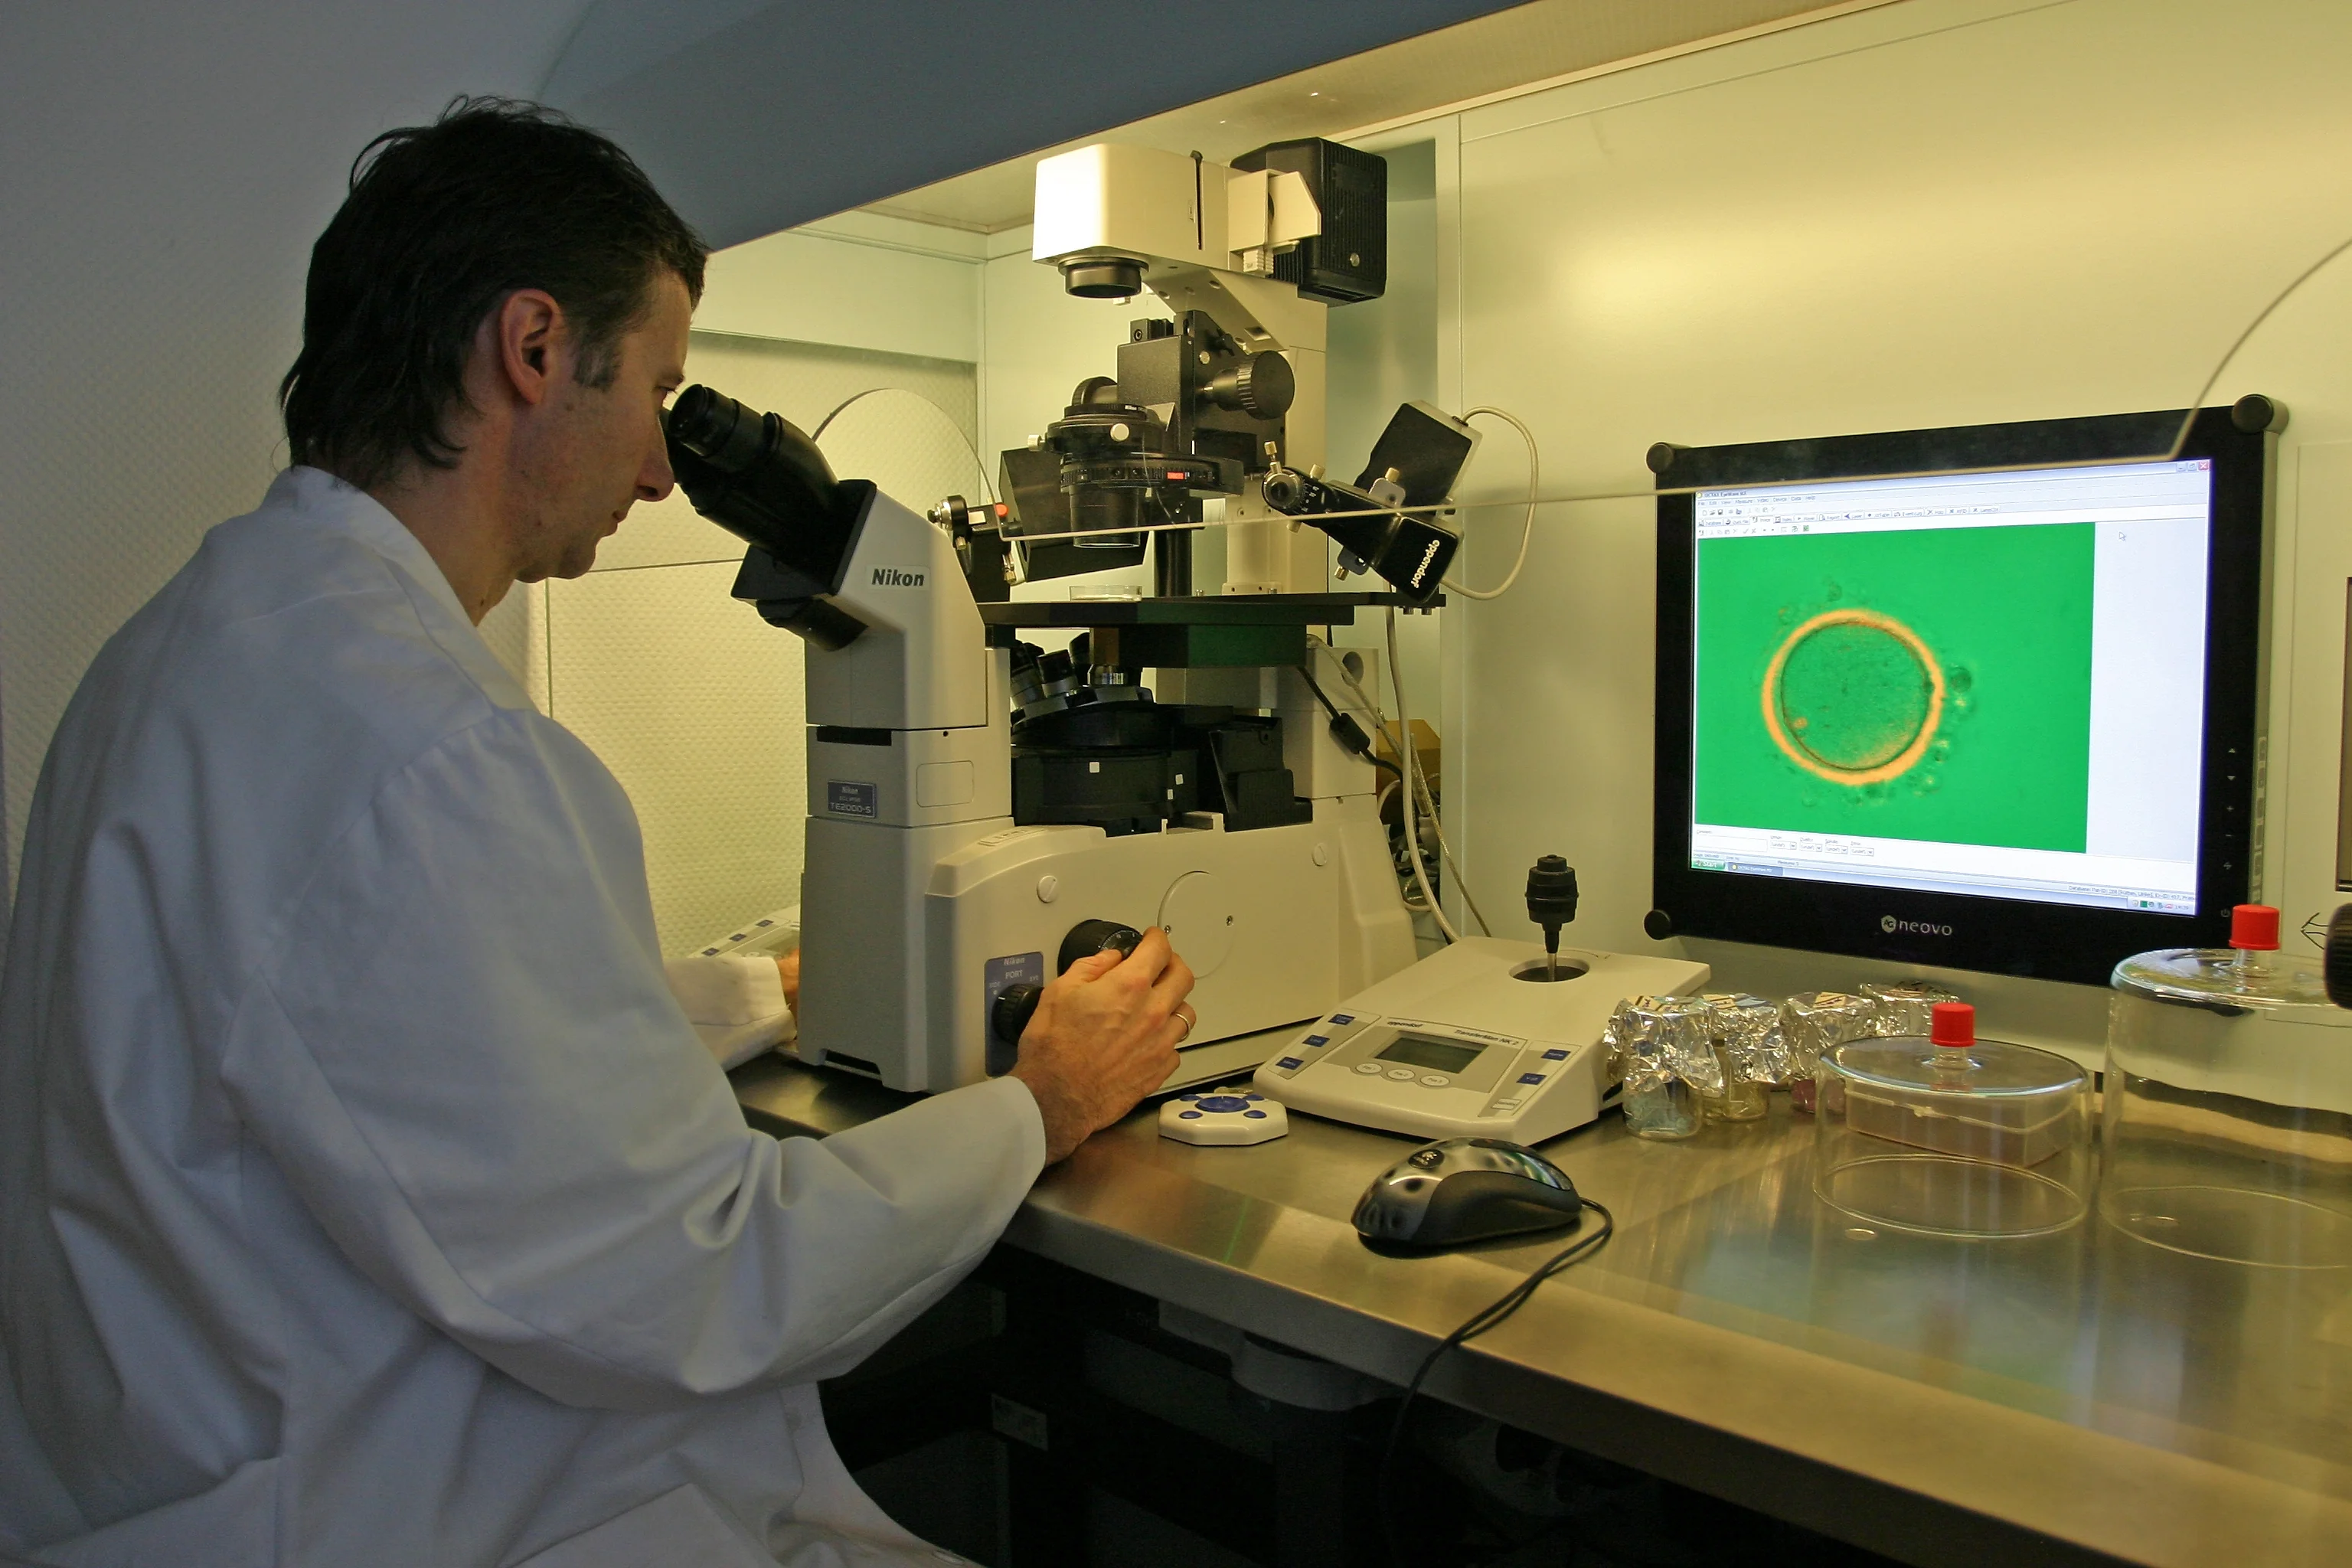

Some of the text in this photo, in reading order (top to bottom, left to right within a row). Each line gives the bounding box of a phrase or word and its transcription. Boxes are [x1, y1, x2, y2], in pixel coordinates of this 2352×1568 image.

[1410, 539, 1440, 589] eppendorf
[871, 568, 925, 586] Nikon
[1899, 920, 1952, 936] neovo
[1004, 957, 1025, 965] Nikon
[1005, 969, 1023, 979] PORT
